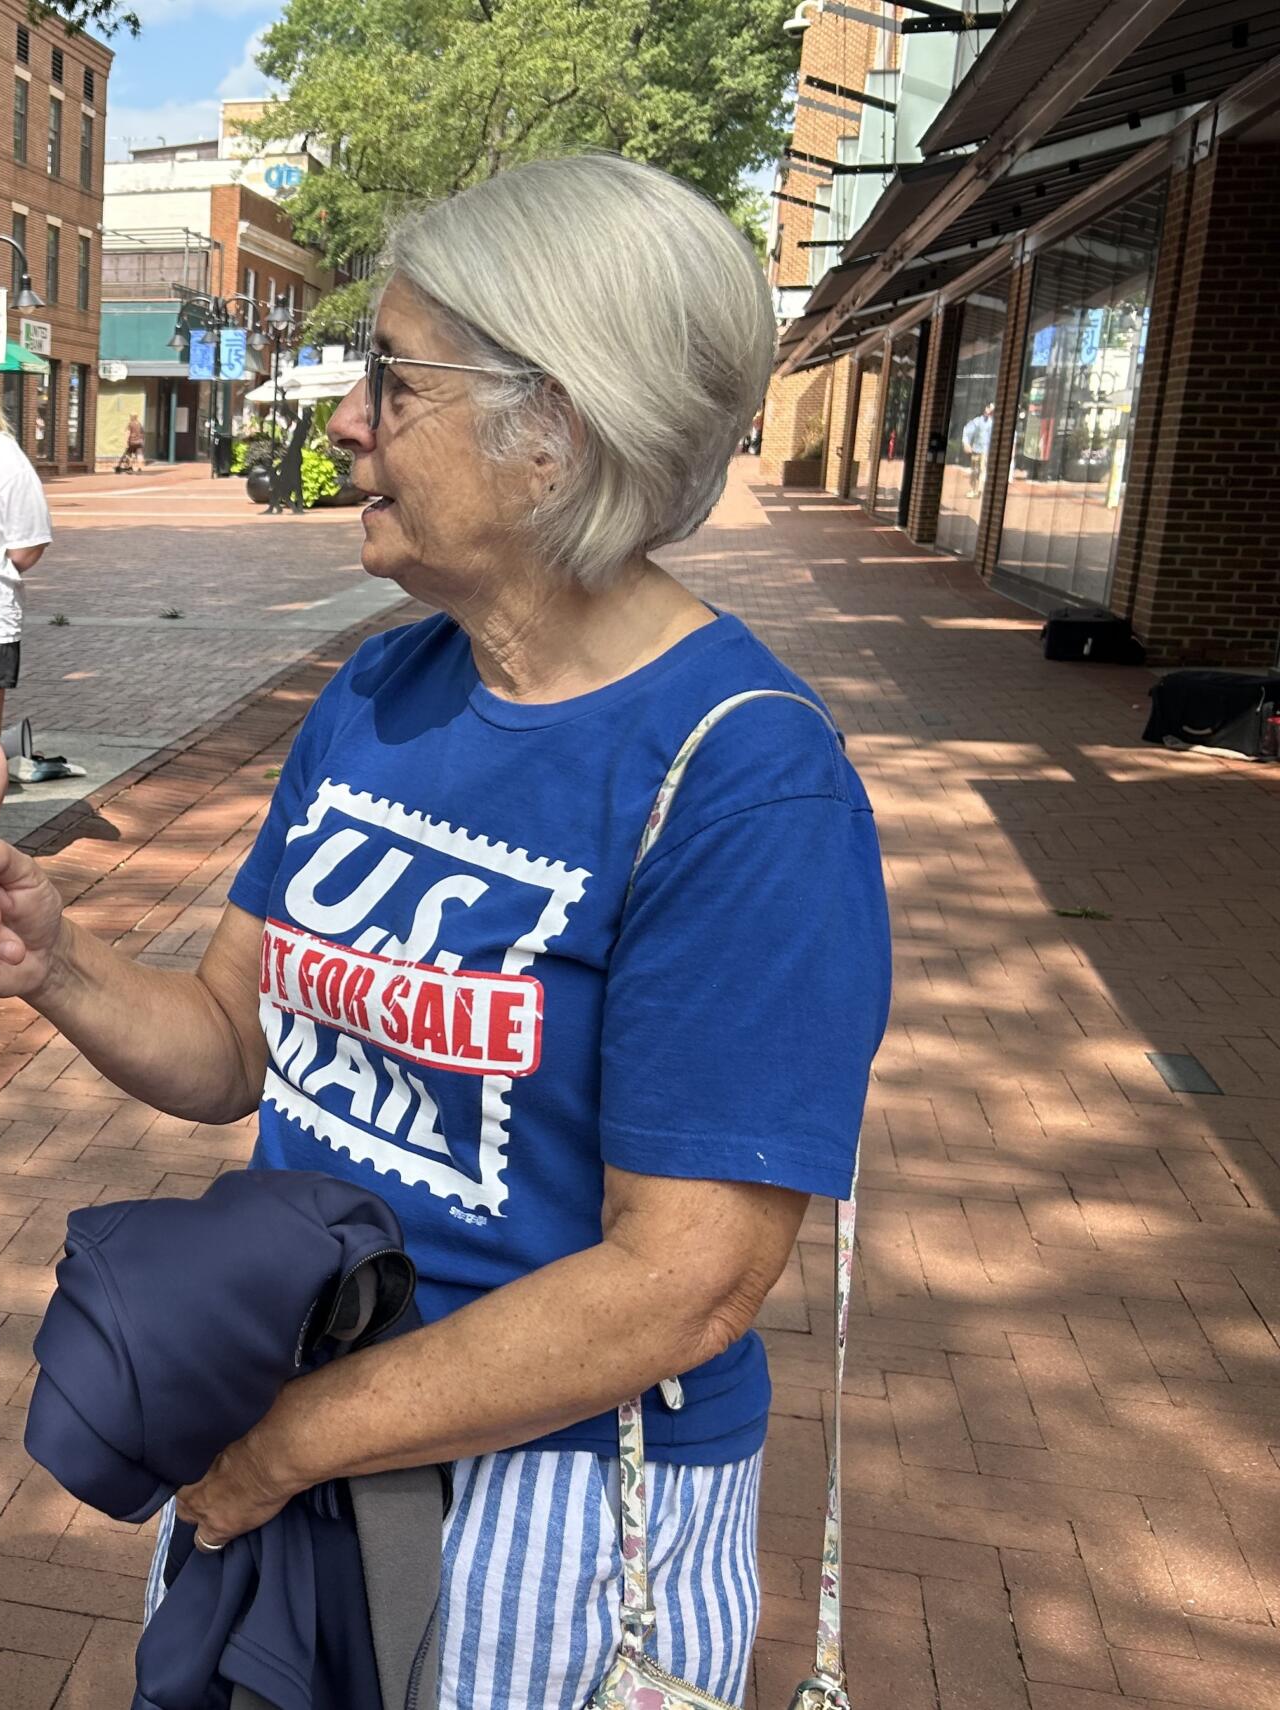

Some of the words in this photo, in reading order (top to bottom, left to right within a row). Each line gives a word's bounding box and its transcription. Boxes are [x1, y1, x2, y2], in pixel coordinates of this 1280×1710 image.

[285, 828, 490, 972] U.S.
[260, 930, 296, 1001] OT
[298, 948, 376, 1032] FOR
[380, 973, 524, 1062] SALE
[259, 1008, 452, 1157] MAIL
